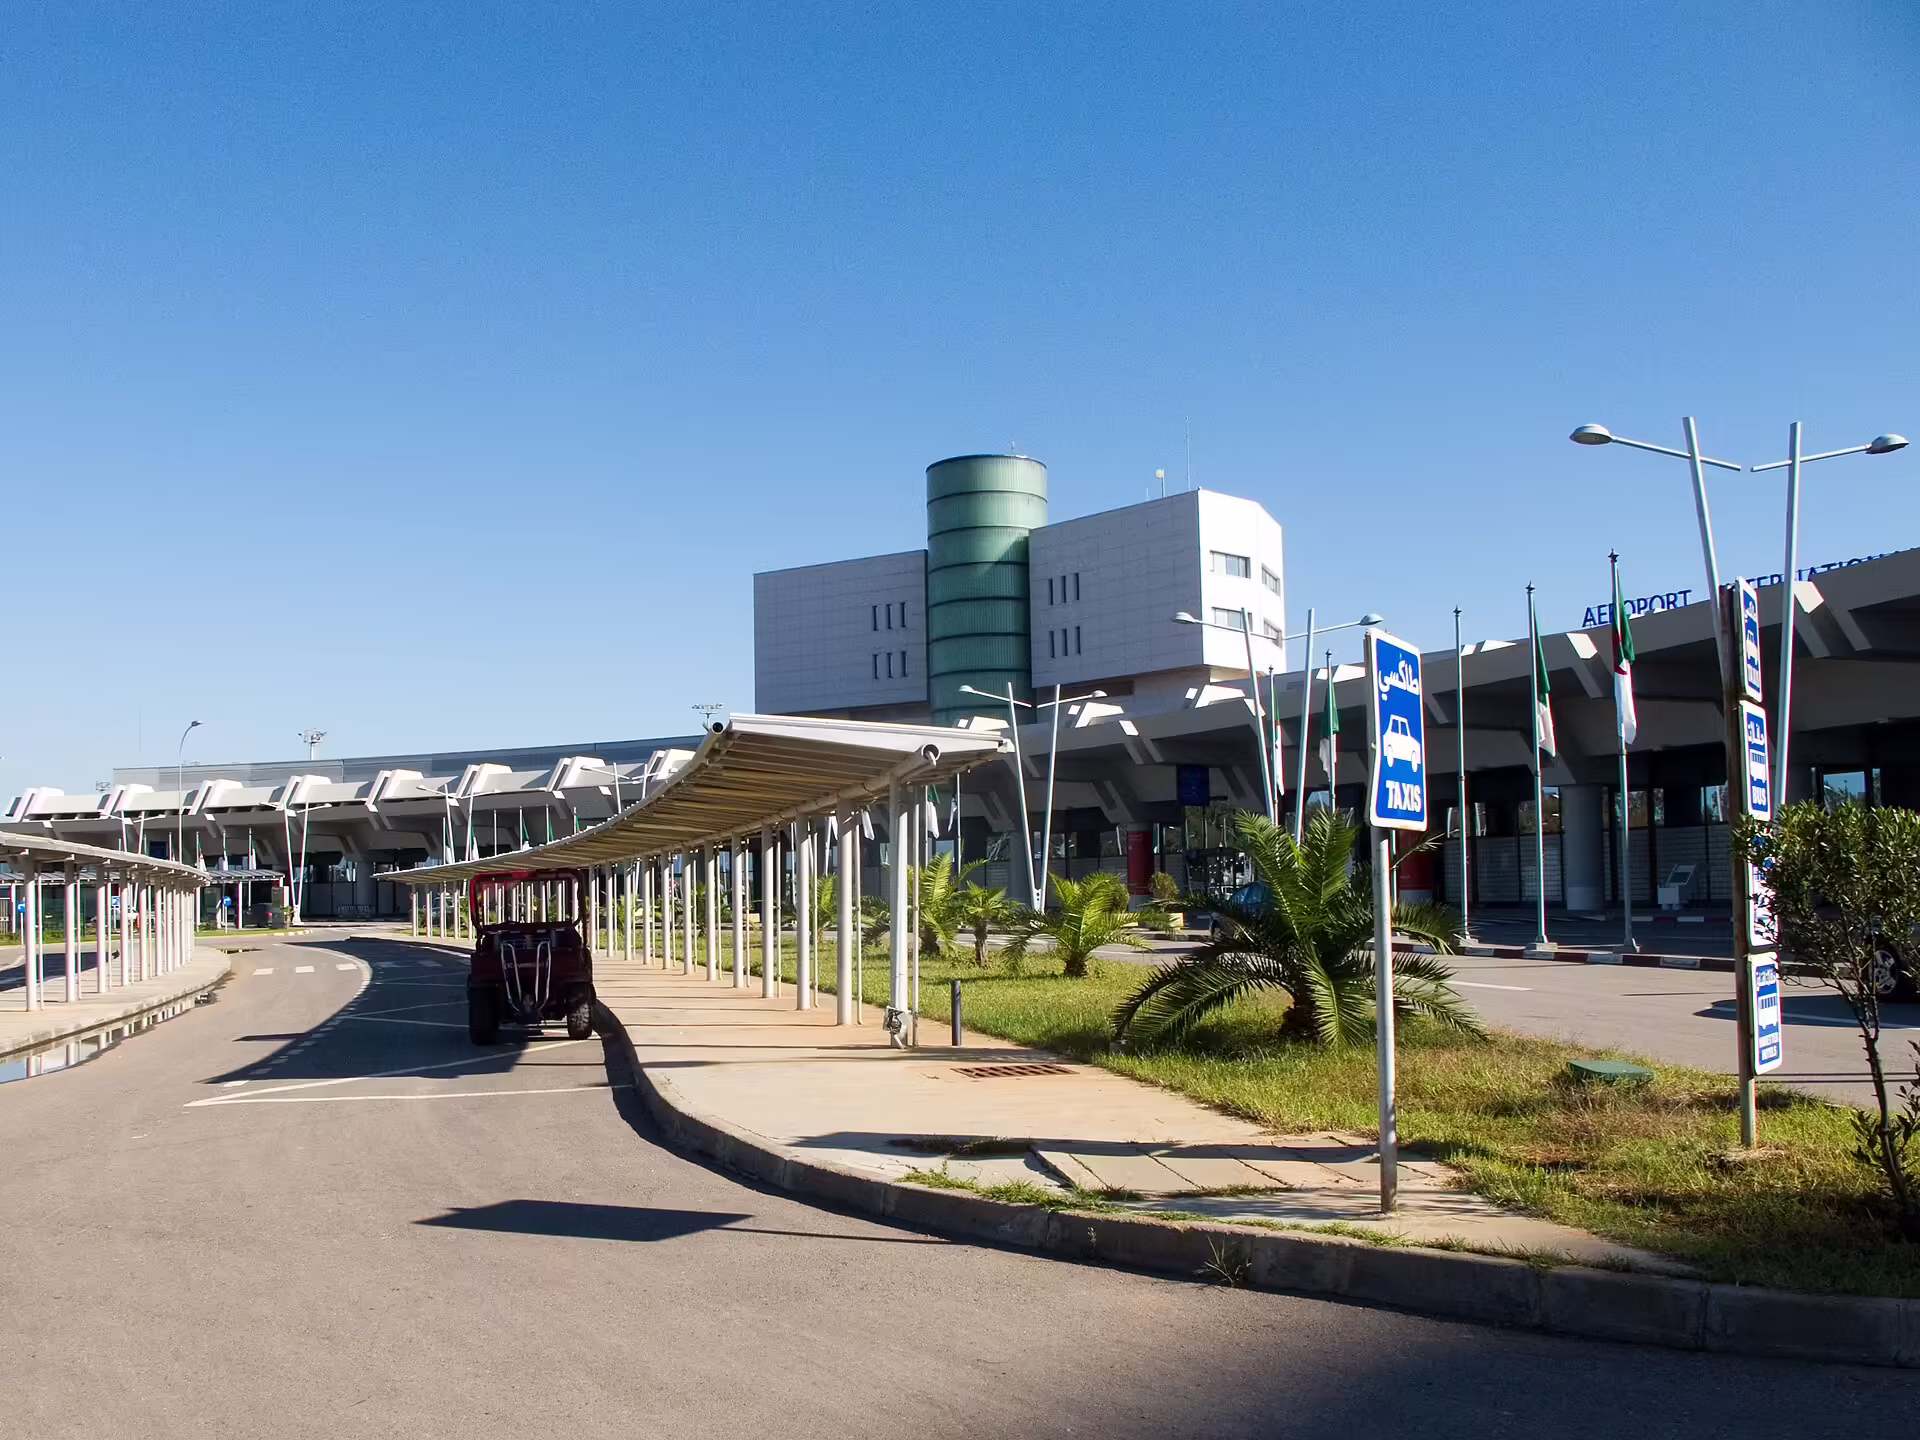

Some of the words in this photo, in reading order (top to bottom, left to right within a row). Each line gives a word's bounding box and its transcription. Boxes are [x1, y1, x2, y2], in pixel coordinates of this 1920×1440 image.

[1378, 659, 1420, 702] طاكسي
[1386, 780, 1422, 813] TAXIS
[1752, 785, 1767, 806] BUS
